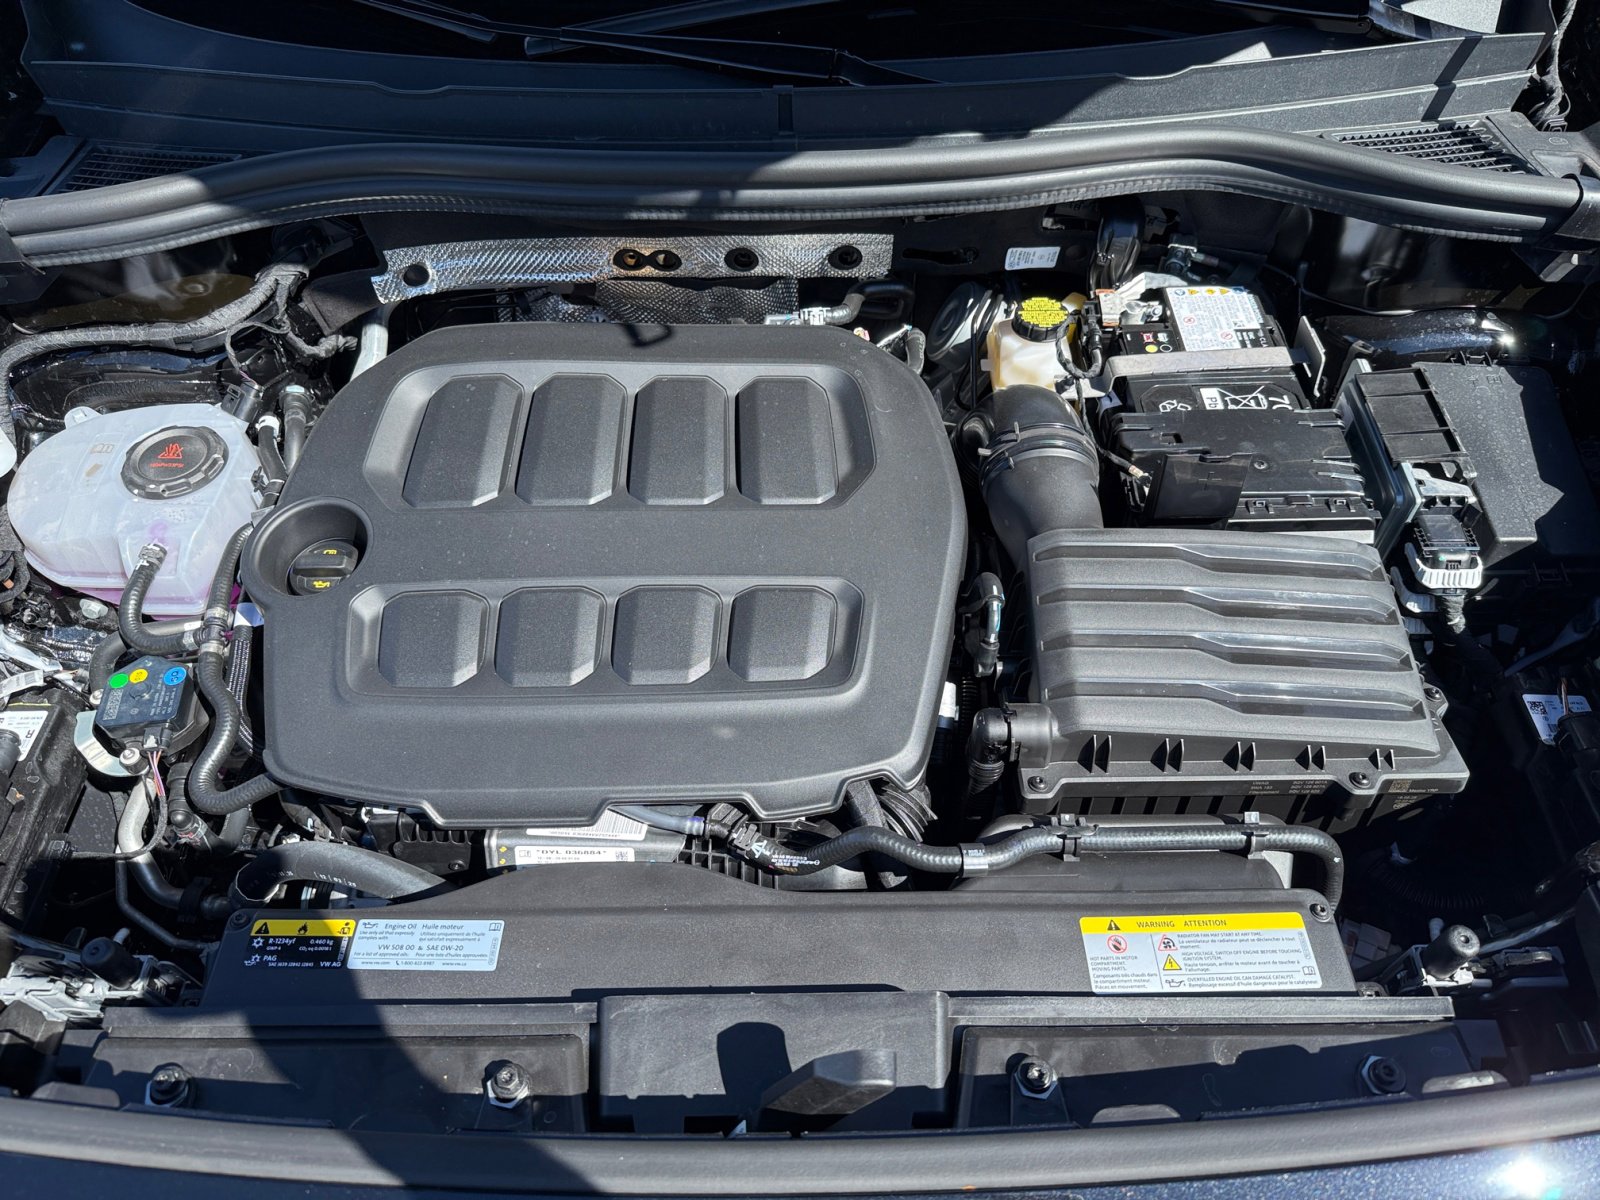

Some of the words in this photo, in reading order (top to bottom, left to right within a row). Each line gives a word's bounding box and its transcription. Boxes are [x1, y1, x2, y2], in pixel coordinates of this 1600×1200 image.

[1206, 397, 1217, 409] Pb
[384, 923, 406, 931] Engine
[1136, 920, 1175, 928] WARNING
[1184, 919, 1227, 928] ATTENTION
[268, 937, 296, 946] R-1234yf
